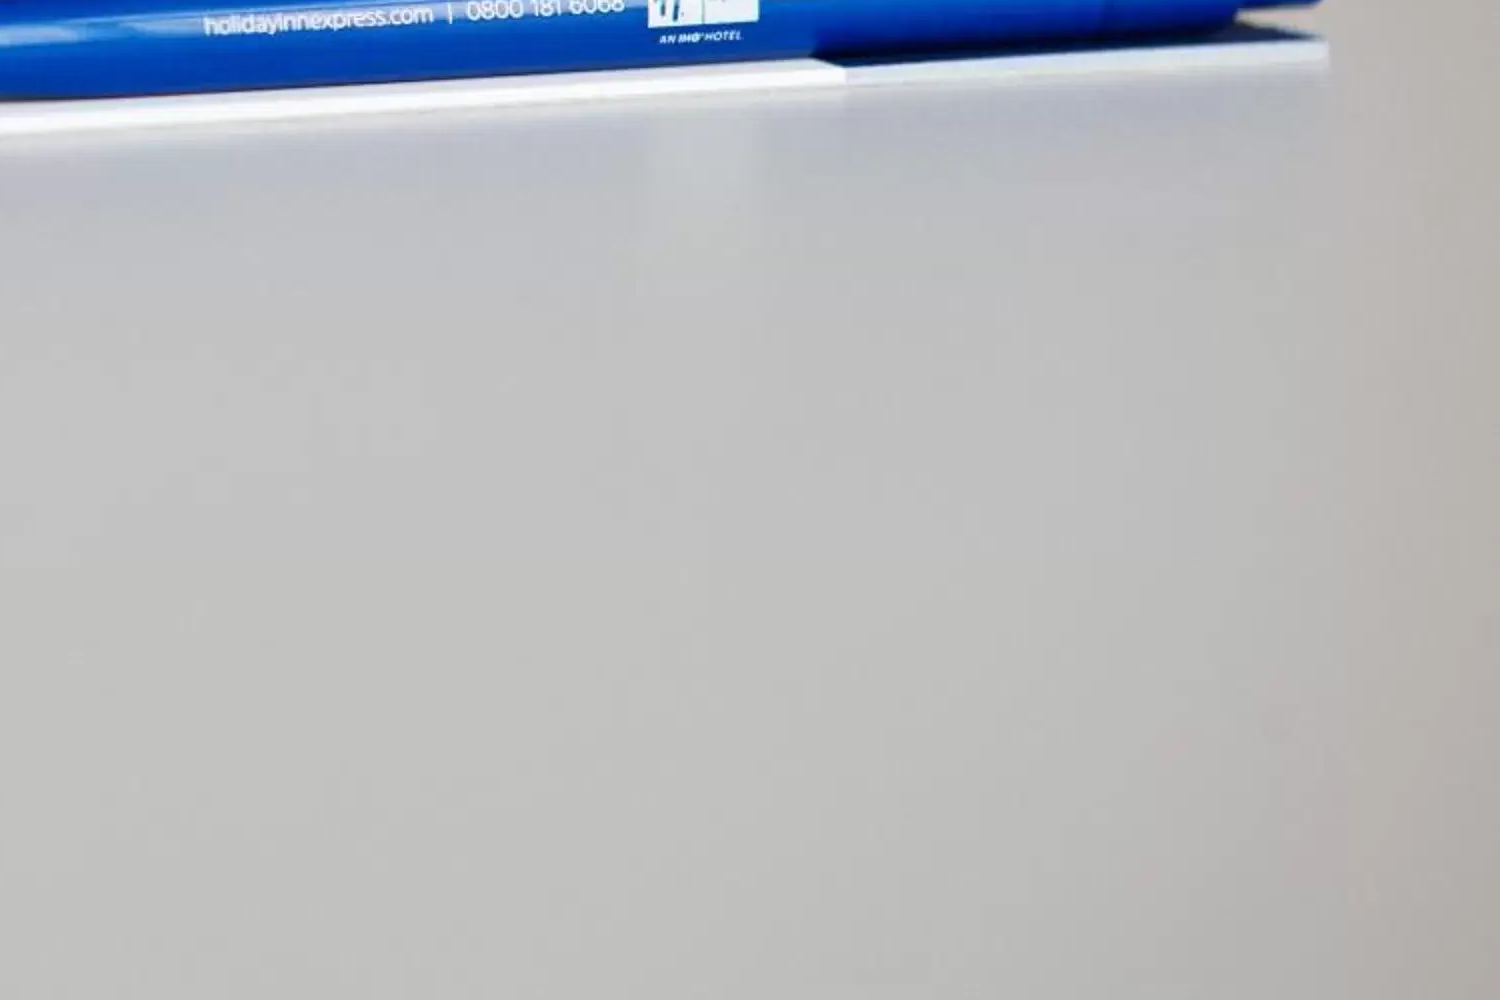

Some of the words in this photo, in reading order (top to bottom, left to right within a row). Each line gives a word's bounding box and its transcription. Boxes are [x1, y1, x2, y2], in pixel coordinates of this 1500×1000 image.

[467, 0, 524, 21] 0800
[659, 35, 676, 44] AN
[704, 30, 742, 41] HOTEL
